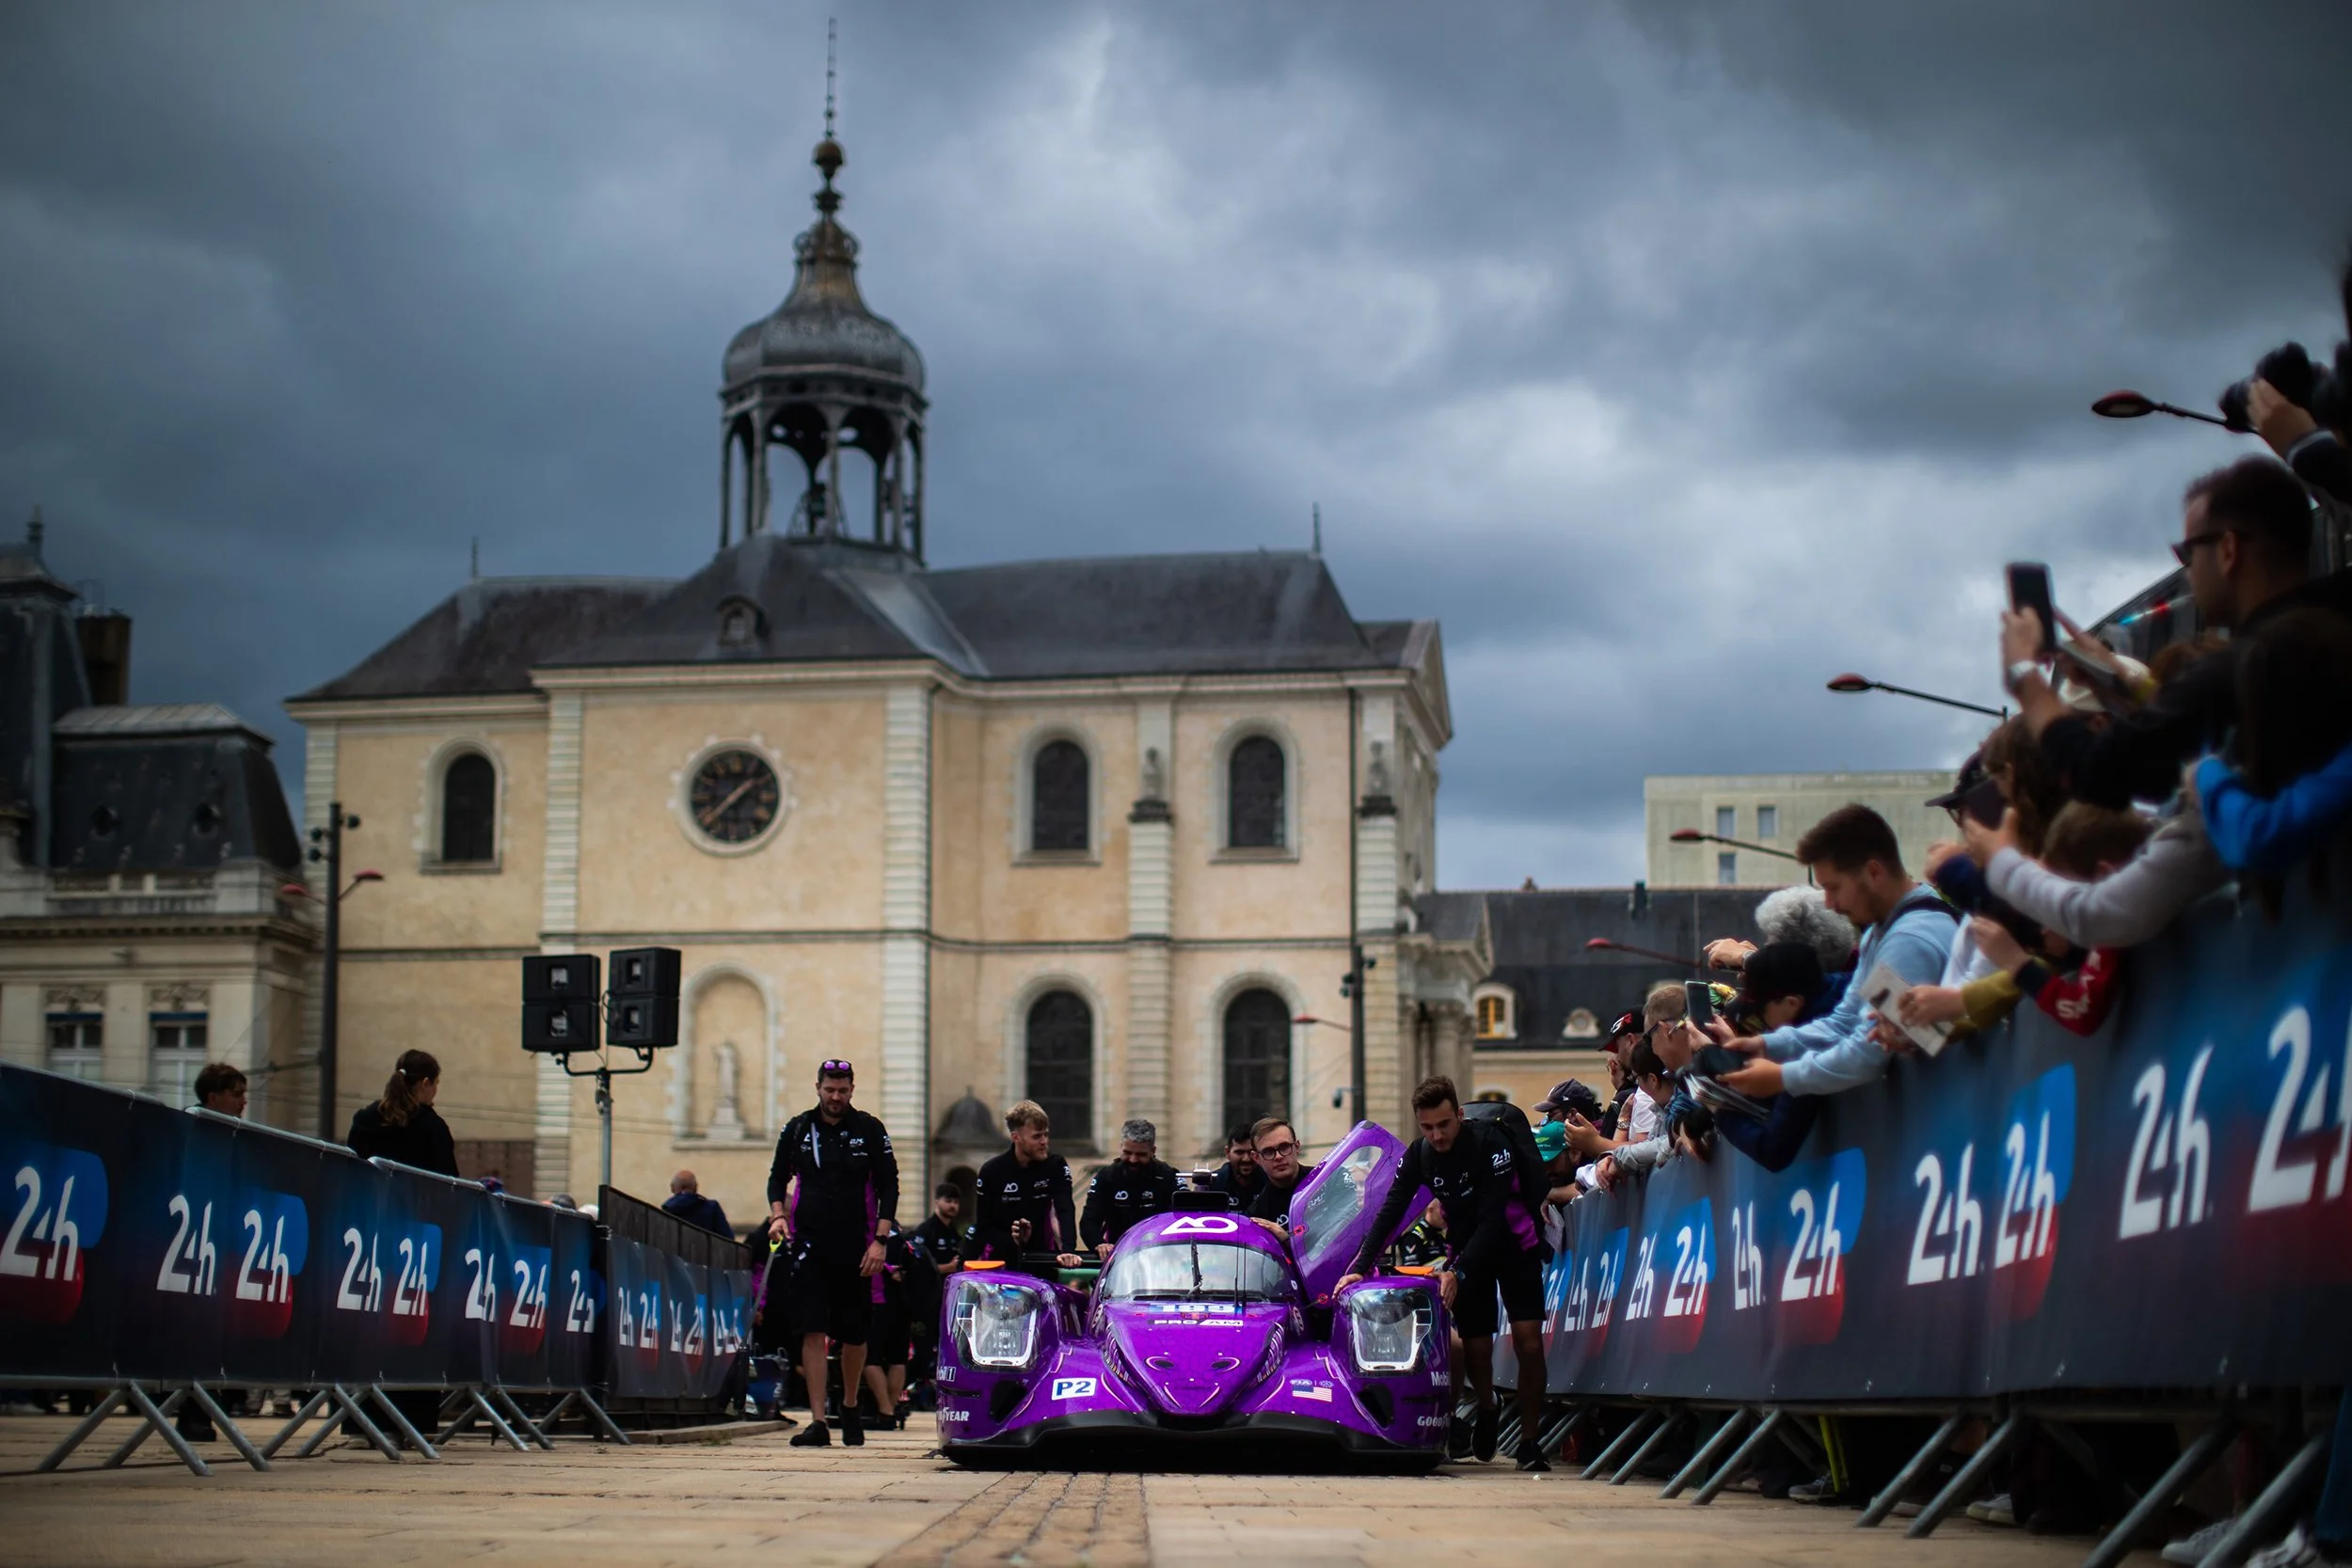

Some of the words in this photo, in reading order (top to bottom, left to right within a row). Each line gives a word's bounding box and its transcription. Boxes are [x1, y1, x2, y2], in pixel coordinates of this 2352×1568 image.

[2119, 1044, 2213, 1241] 24h
[0, 1166, 78, 1281] 24h
[1907, 1143, 1982, 1286] 24h
[1995, 1109, 2056, 1269] 24h
[157, 1195, 215, 1296] 24h
[236, 1210, 289, 1304] 24h
[337, 1227, 381, 1313] 24h
[393, 1237, 427, 1317] 24h
[1626, 1232, 1657, 1321] 24h
[1664, 1223, 1708, 1317] 24h
[1732, 1200, 1761, 1310] 24h
[1781, 1181, 1841, 1302] 24h
[465, 1248, 496, 1323] 24h
[509, 1259, 547, 1329] 24h
[618, 1286, 634, 1347] 24h
[640, 1291, 659, 1350] 24h
[1542, 1267, 1565, 1334] 24h
[1592, 1251, 1619, 1329] 24h
[1056, 1381, 1091, 1396] P2
[1431, 1371, 1451, 1386] Mobi
